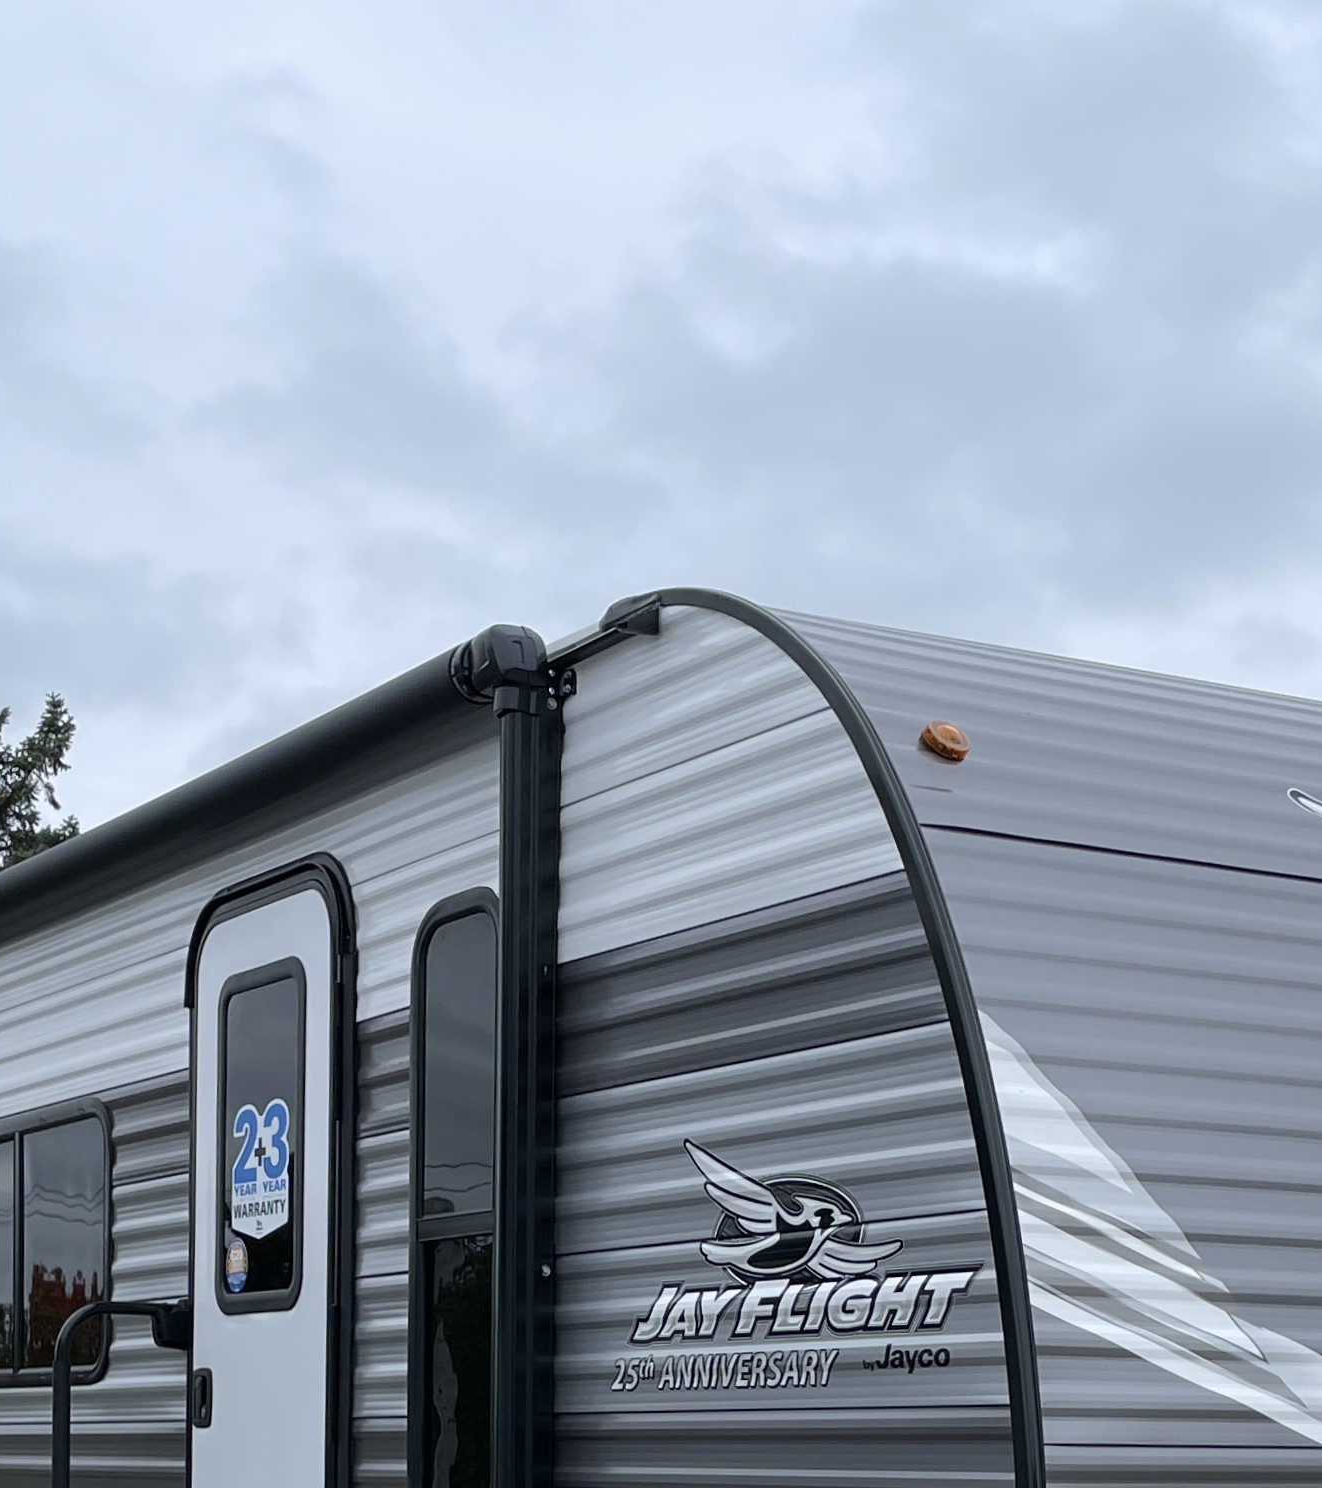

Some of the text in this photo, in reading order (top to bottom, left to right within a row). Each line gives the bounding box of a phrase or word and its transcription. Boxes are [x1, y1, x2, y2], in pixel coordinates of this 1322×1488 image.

[234, 1179, 286, 1196] YEAR YEAR
[234, 1199, 286, 1219] WARRANTY
[629, 1268, 980, 1344] JAY FLIGHT
[658, 1348, 840, 1391] ANNIVERSARY
[877, 1343, 951, 1374] Jayco
